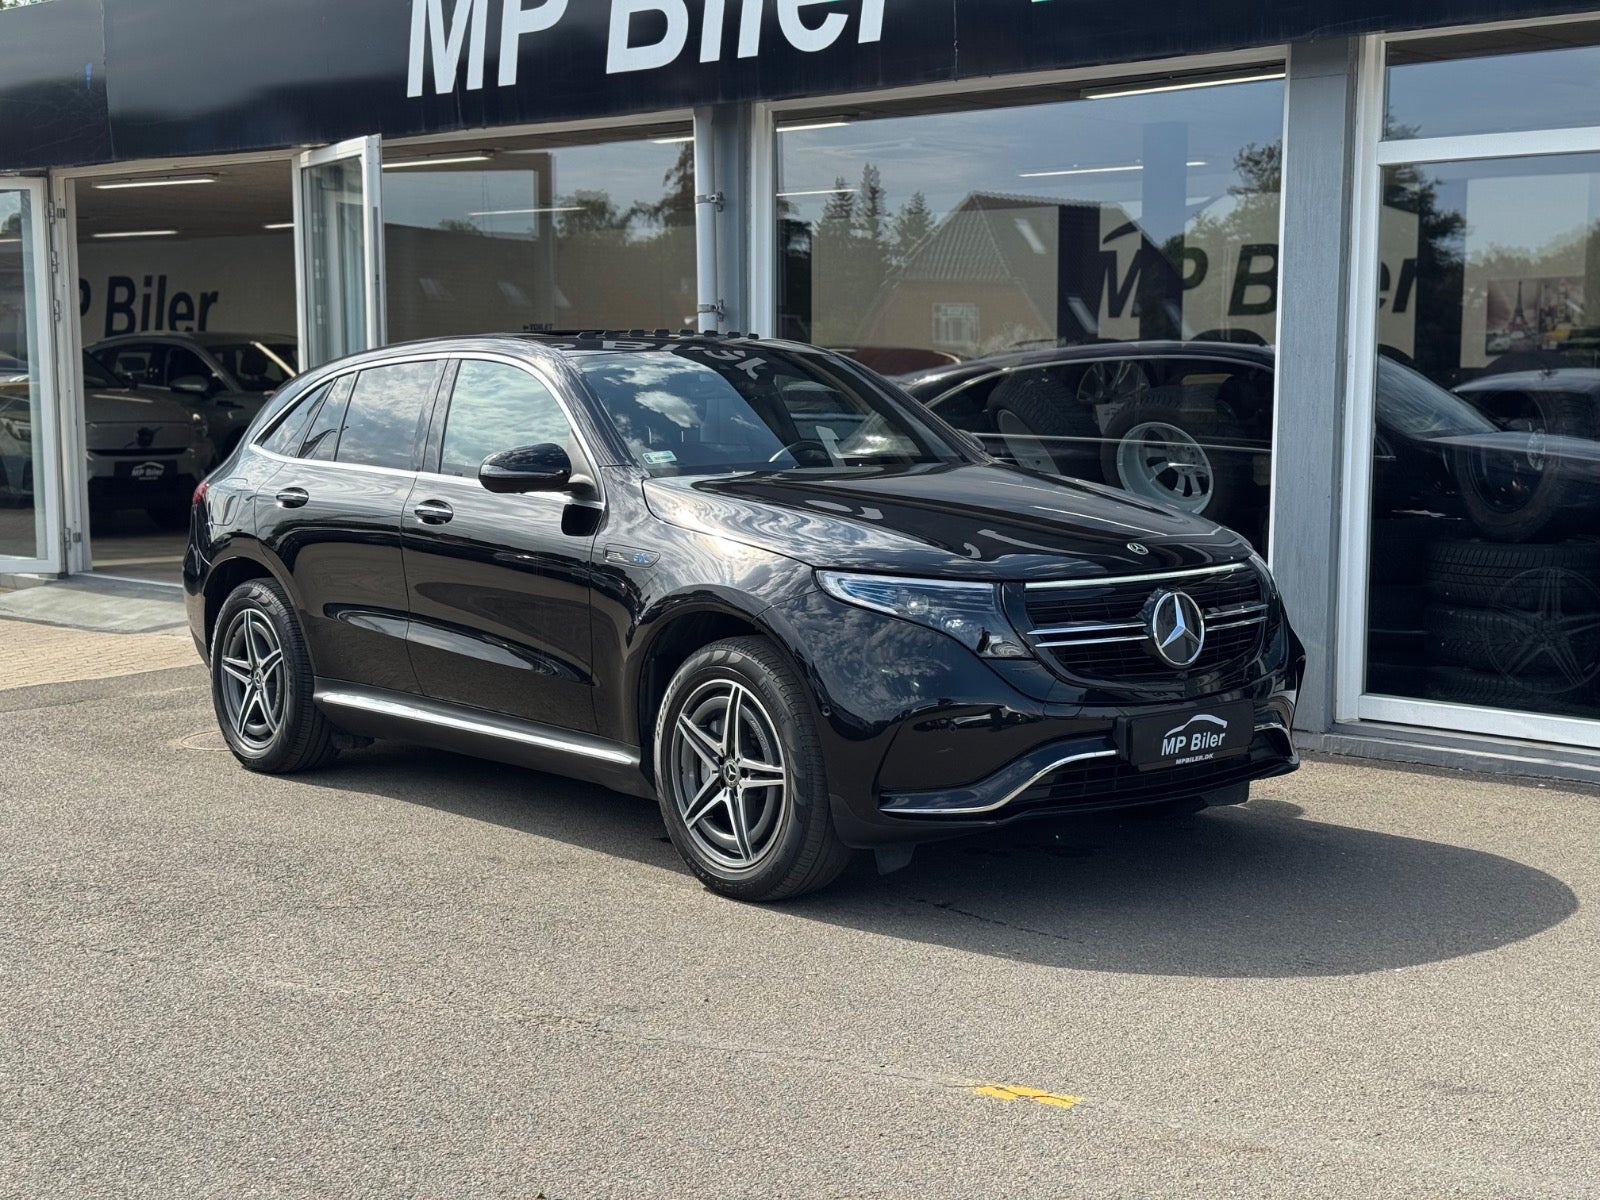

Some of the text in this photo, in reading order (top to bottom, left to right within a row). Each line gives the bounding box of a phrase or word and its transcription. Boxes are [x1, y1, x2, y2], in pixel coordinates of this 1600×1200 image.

[104, 274, 219, 338] Biler
[1161, 731, 1226, 756] MP Biler
